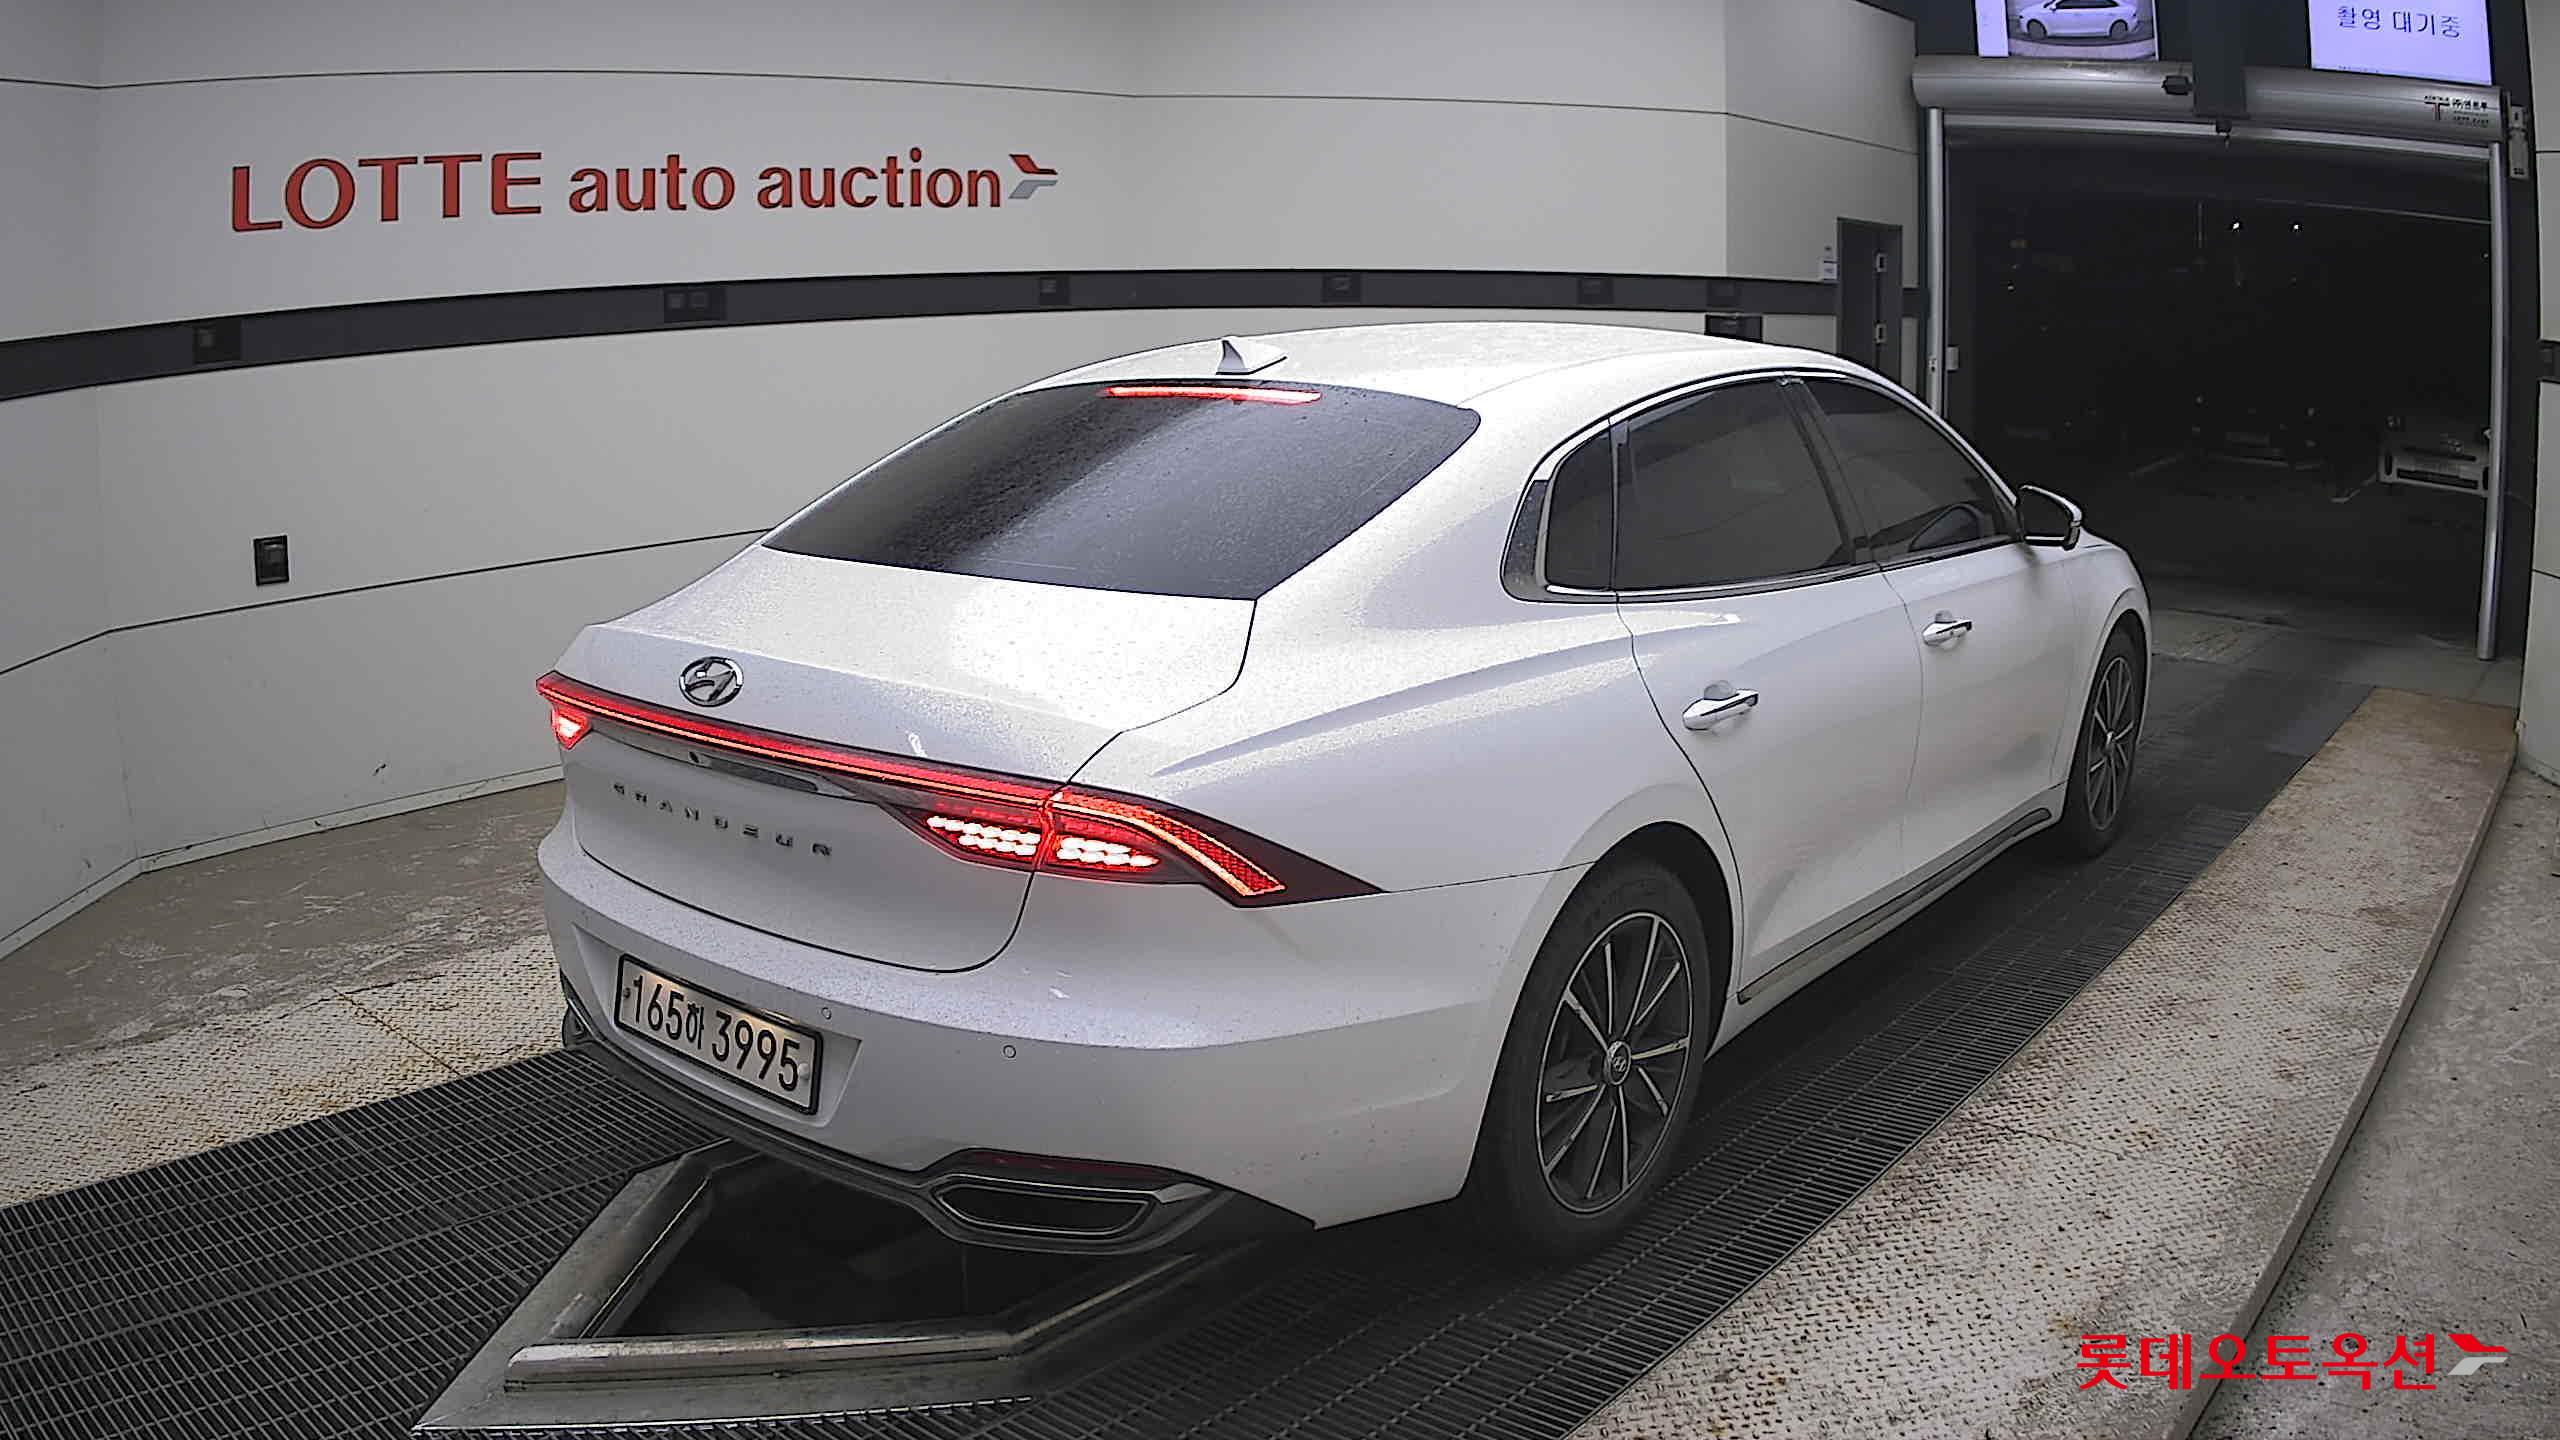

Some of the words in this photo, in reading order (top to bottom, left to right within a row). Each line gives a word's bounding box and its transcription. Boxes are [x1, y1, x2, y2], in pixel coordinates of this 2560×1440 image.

[2337, 5, 2381, 31] 촬영
[2392, 11, 2461, 39] 대기중
[232, 152, 542, 232] LOTTE
[568, 153, 736, 214] auto
[757, 147, 1001, 209] auction
[711, 1010, 801, 1092] 3995
